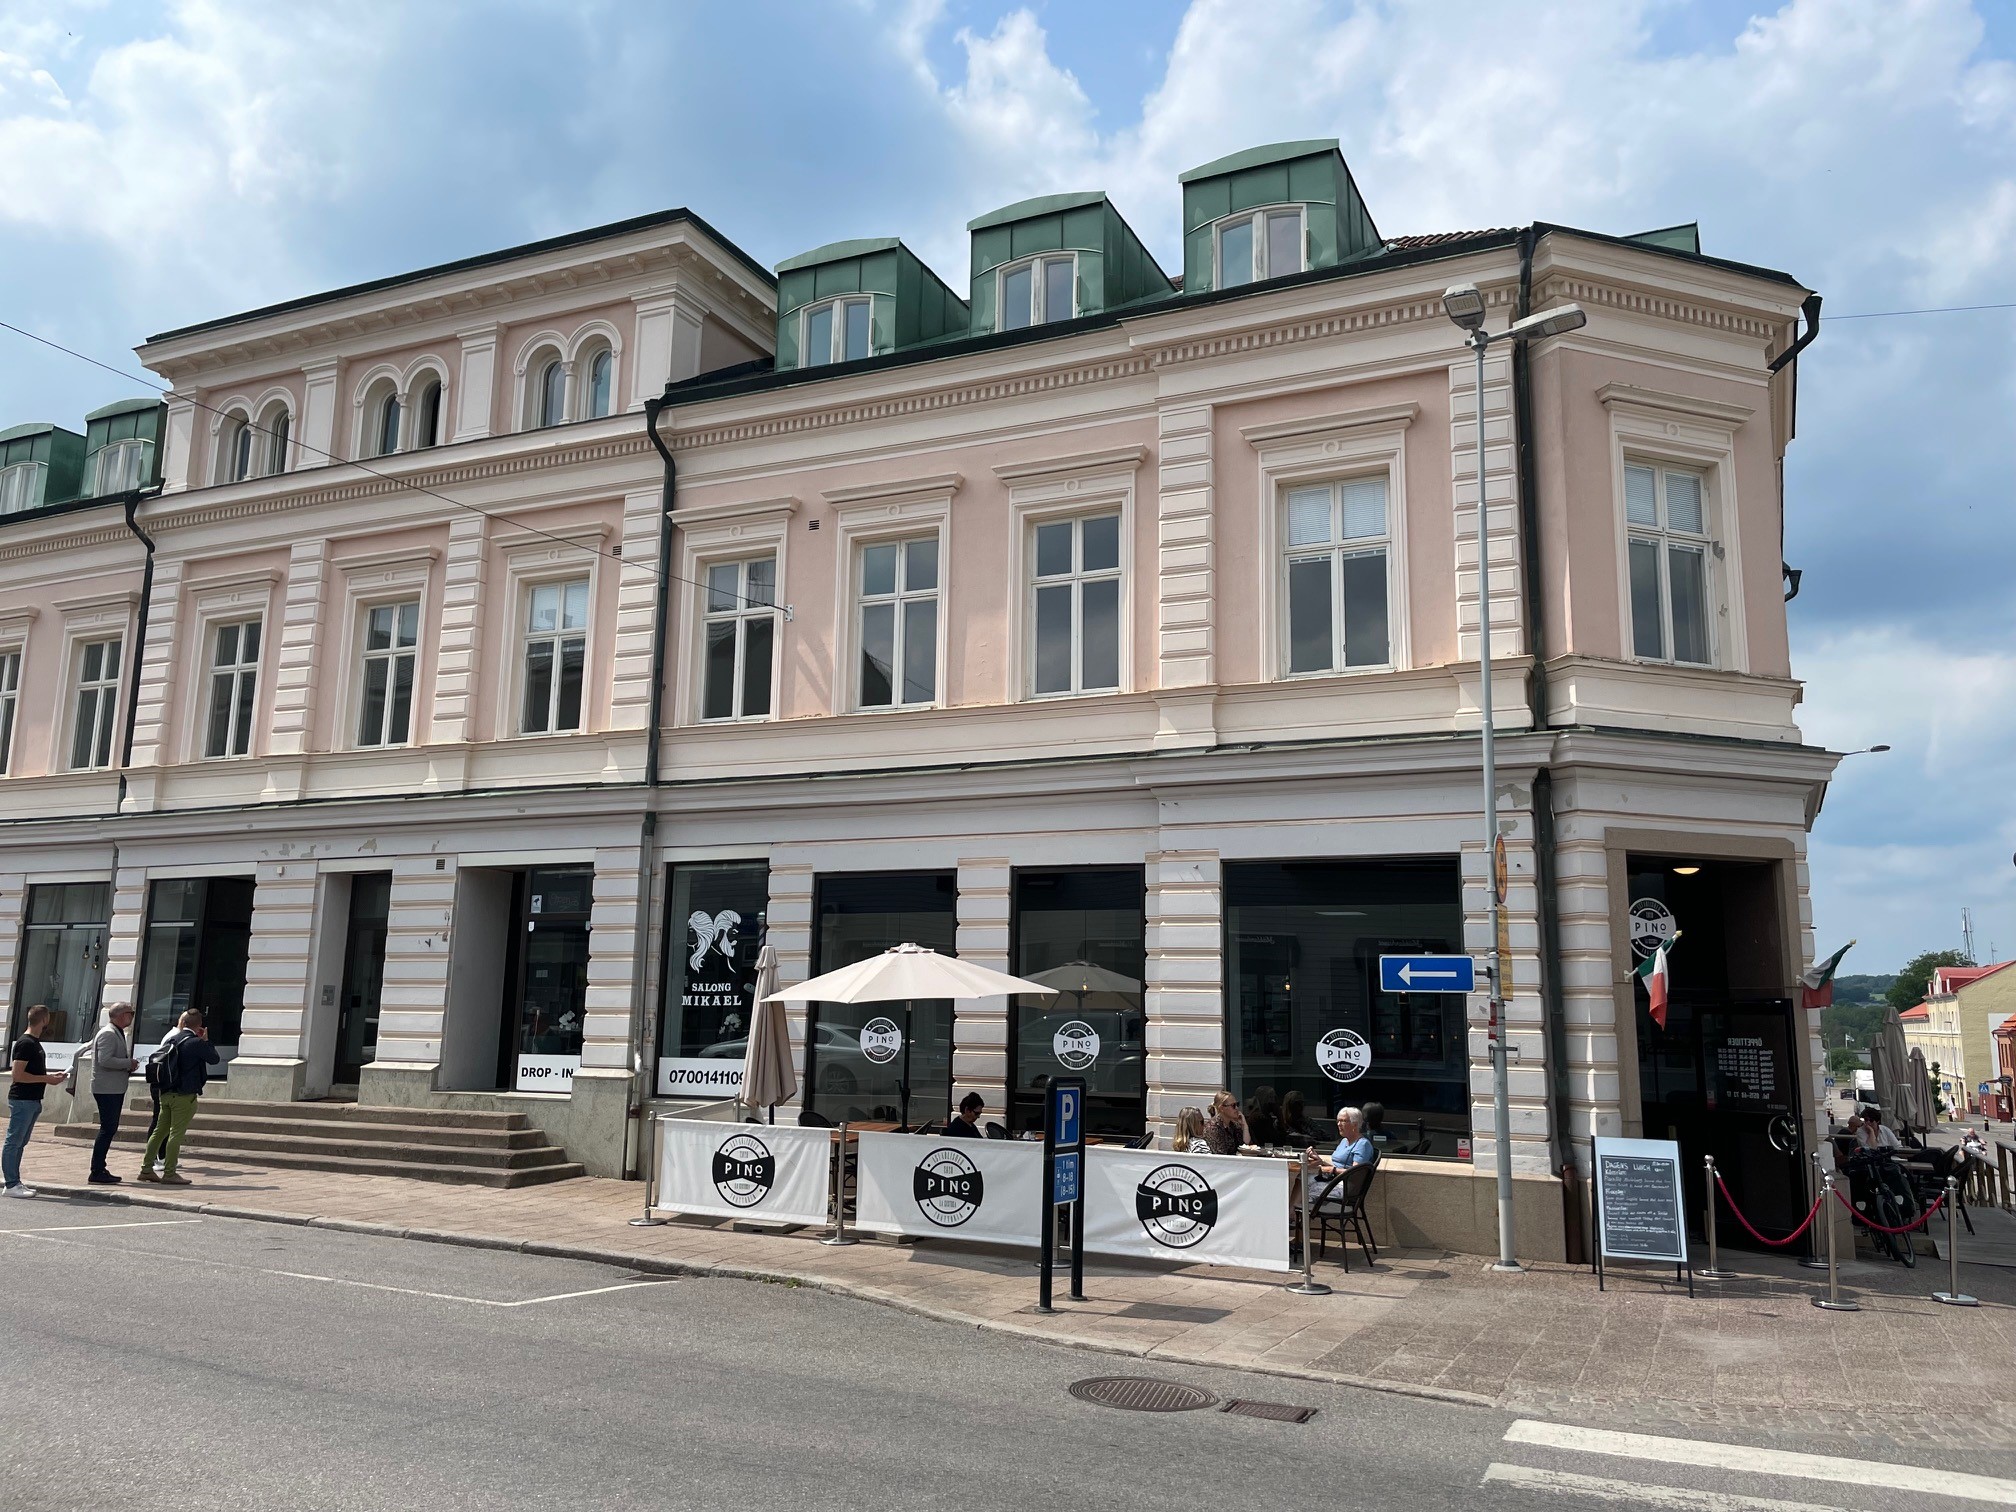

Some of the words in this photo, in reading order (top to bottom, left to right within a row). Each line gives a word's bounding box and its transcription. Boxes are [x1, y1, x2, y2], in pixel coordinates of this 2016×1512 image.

[1635, 922, 1667, 934] PINO
[691, 982, 732, 992] SALONG
[681, 995, 742, 1006] MIKAEL
[868, 1035, 894, 1045] PINO
[1062, 1040, 1091, 1050] PINO
[1327, 1050, 1361, 1060] PINO
[521, 1067, 552, 1078] DROP
[561, 1068, 574, 1078] IN
[1061, 1094, 1075, 1140] P
[931, 1151, 965, 1165] ESTABLISHED
[724, 1162, 764, 1178] PINO
[1605, 1160, 1629, 1170] DAGENS
[1157, 1167, 1196, 1183] ESTABLISHED
[927, 1178, 971, 1195] PINO
[1152, 1196, 1203, 1215] PINO
